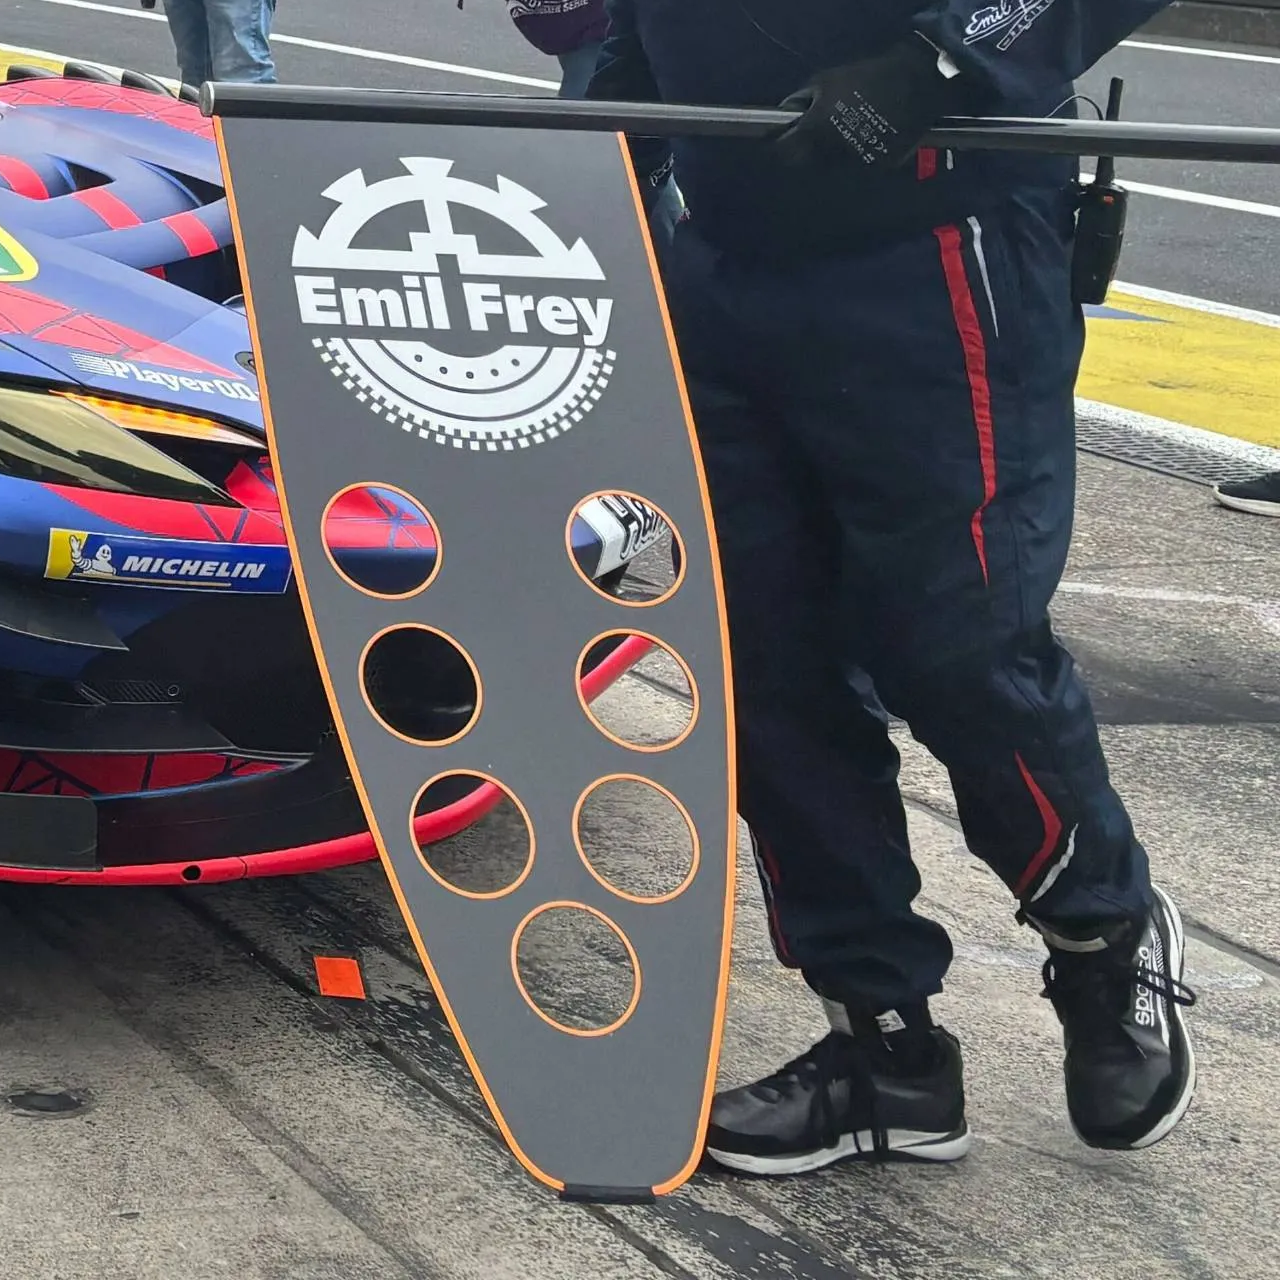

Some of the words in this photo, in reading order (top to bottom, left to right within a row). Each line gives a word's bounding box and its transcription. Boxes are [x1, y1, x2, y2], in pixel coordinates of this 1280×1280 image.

[290, 274, 452, 332] Emil
[463, 281, 614, 348] Frey
[121, 553, 266, 583] MICHELIN
